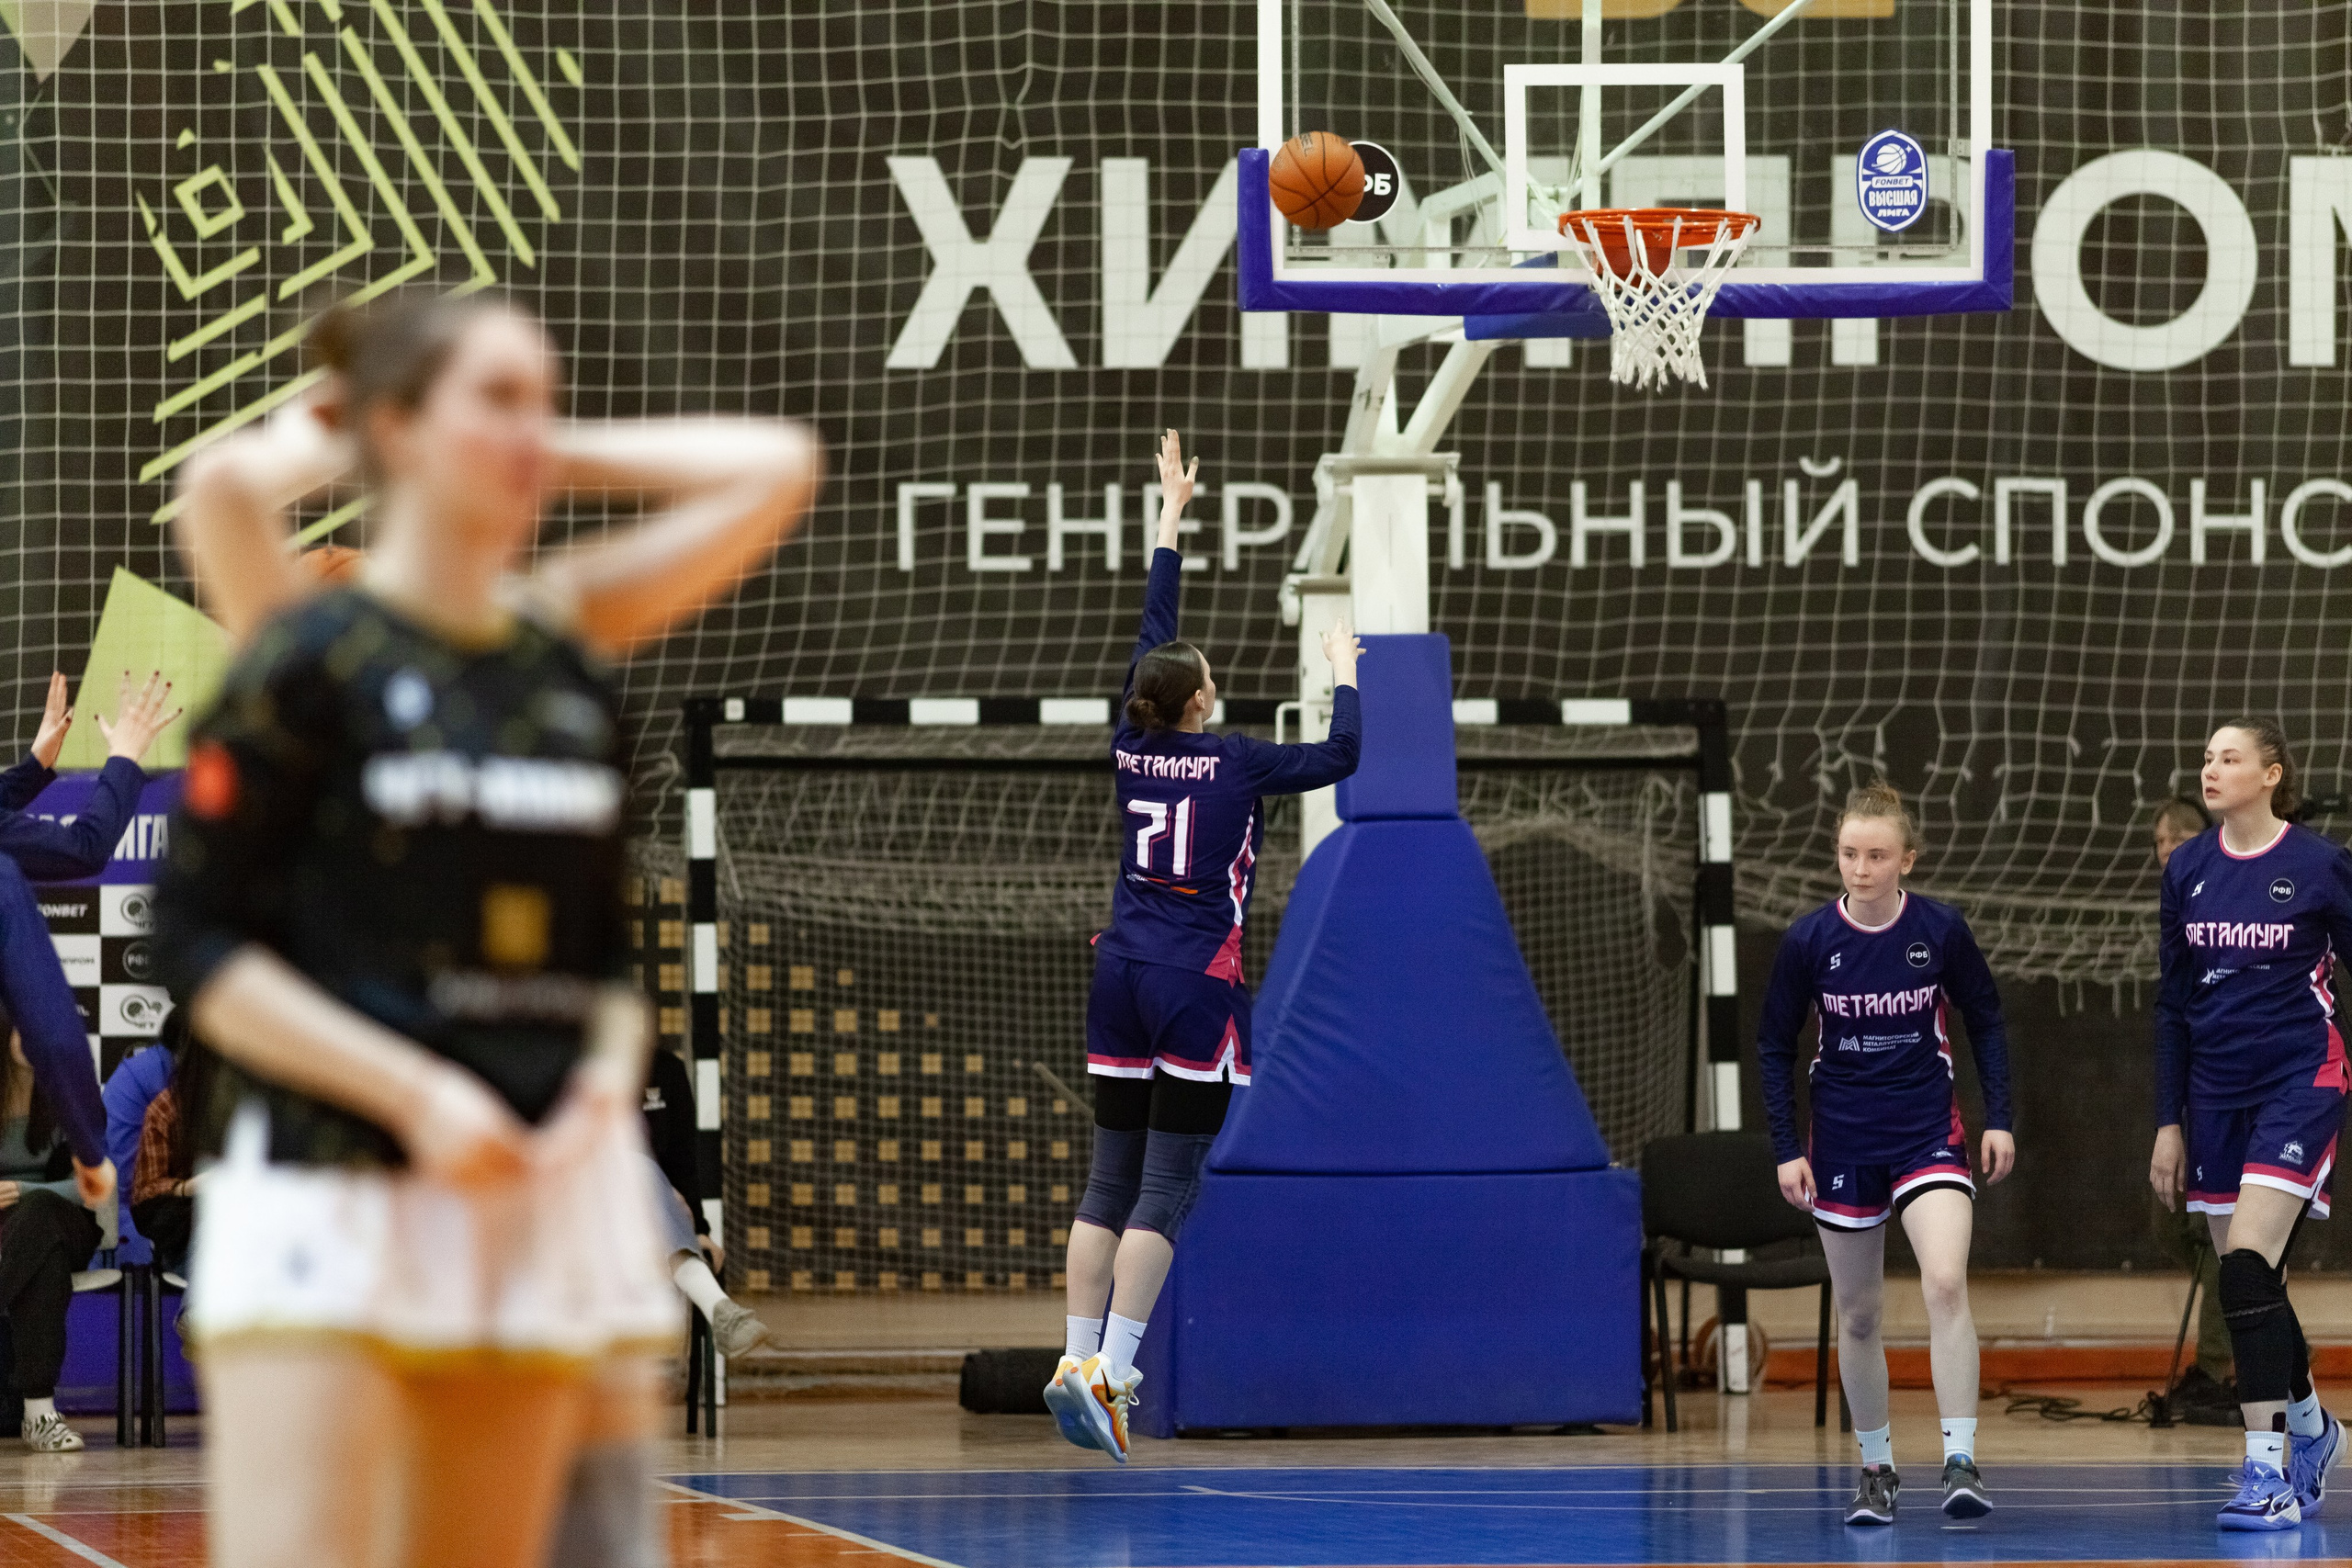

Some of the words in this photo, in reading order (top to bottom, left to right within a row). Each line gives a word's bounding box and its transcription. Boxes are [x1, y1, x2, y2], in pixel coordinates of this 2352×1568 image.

[1874, 177, 1910, 186] FONBET
[1868, 189, 1918, 207] ВЫСШАЯ
[1877, 208, 1910, 218] ЛИГА
[896, 456, 1860, 573] ГЕНЕРЬНЫЙ
[1115, 749, 1221, 781] МЕТАЛЛУРГ
[108, 814, 169, 862] ИГА
[1126, 795, 1194, 878] 71
[2272, 886, 2292, 896] РФБ
[2186, 921, 2295, 950] МЕТАЛЛУРГ
[1909, 950, 1928, 960] РФБ
[1822, 983, 1938, 1019] МЕТАЛЛУРГ
